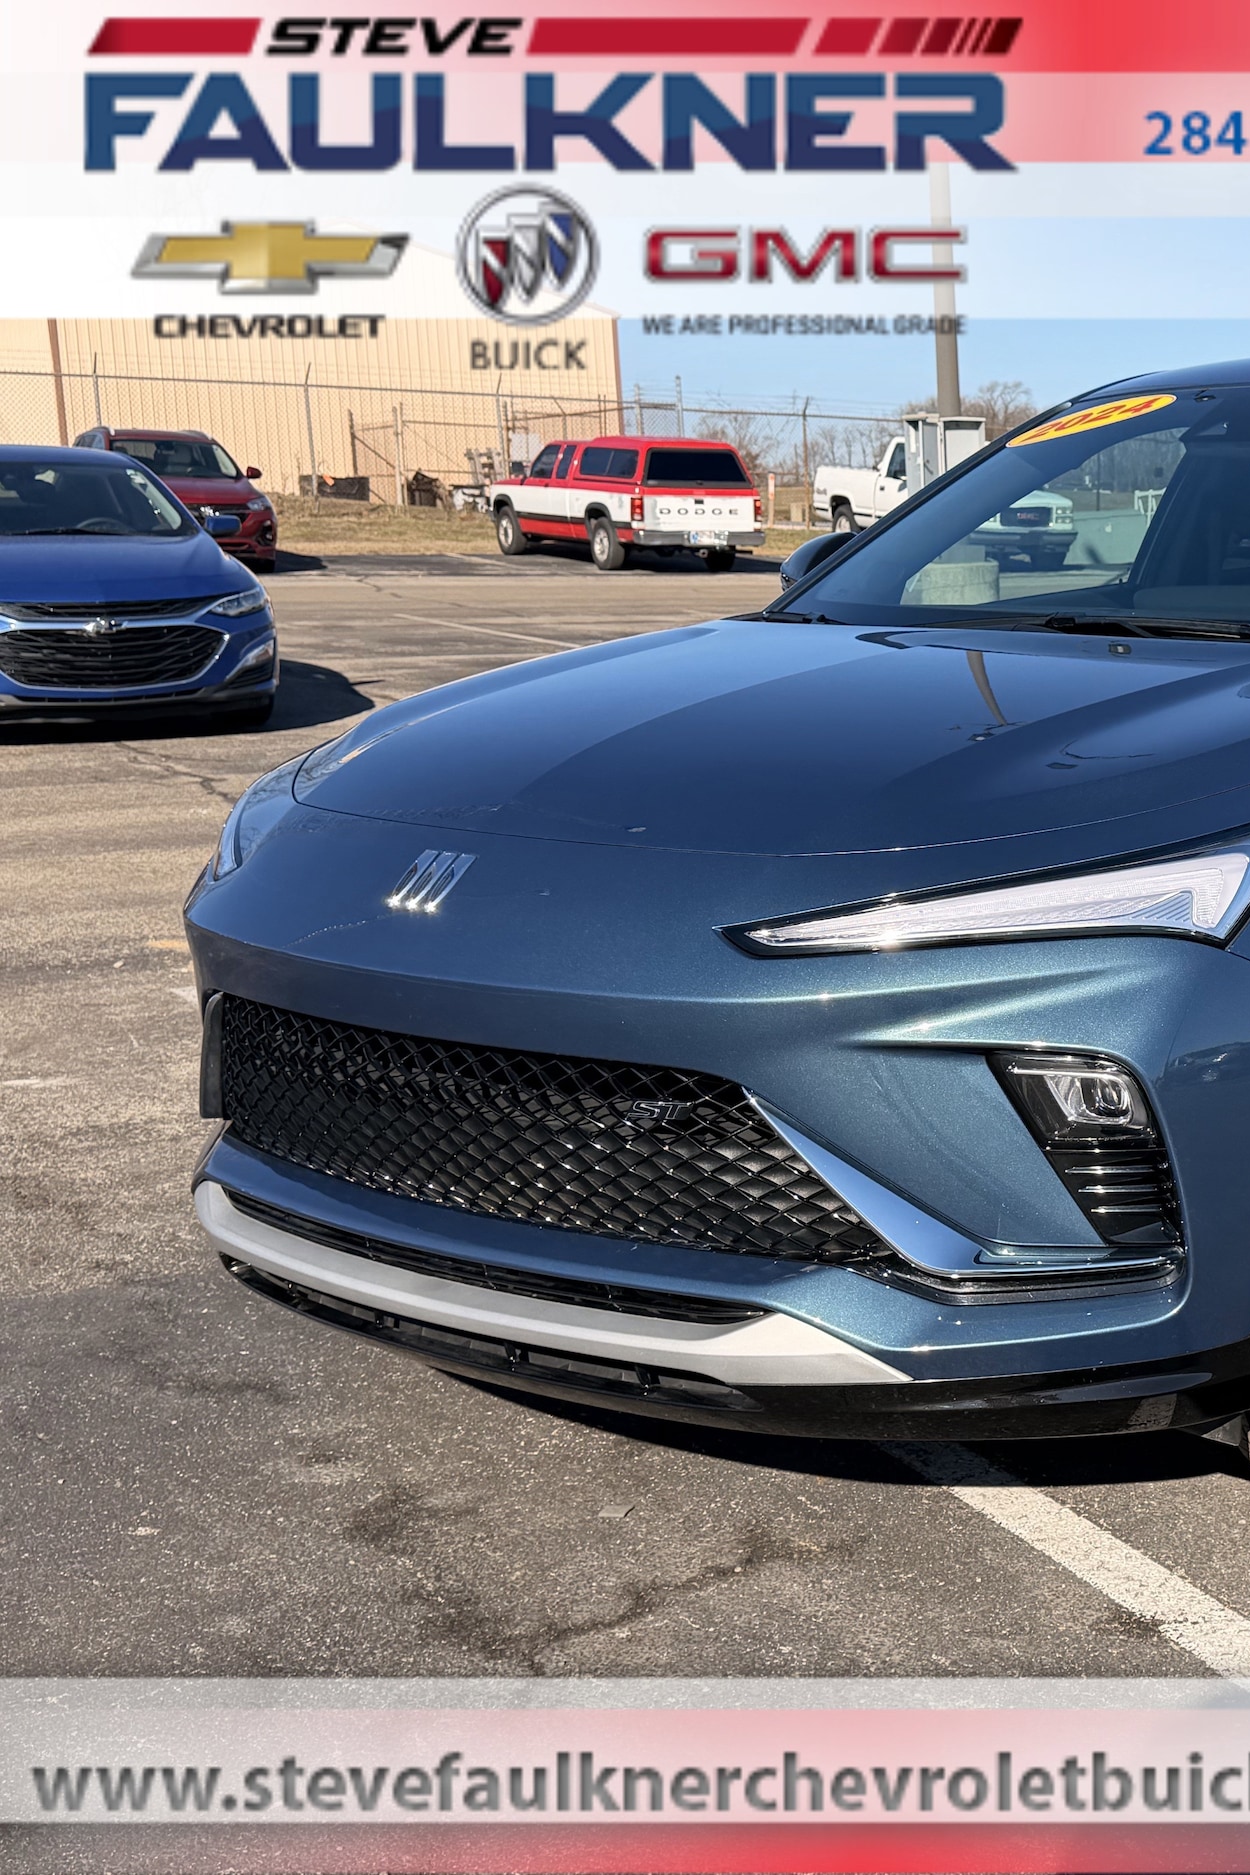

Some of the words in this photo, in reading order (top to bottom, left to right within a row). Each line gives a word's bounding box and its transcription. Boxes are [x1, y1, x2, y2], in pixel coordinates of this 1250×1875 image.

[1019, 396, 1162, 444] 2024
[659, 507, 738, 516] DODGE
[624, 1100, 692, 1121] ST
